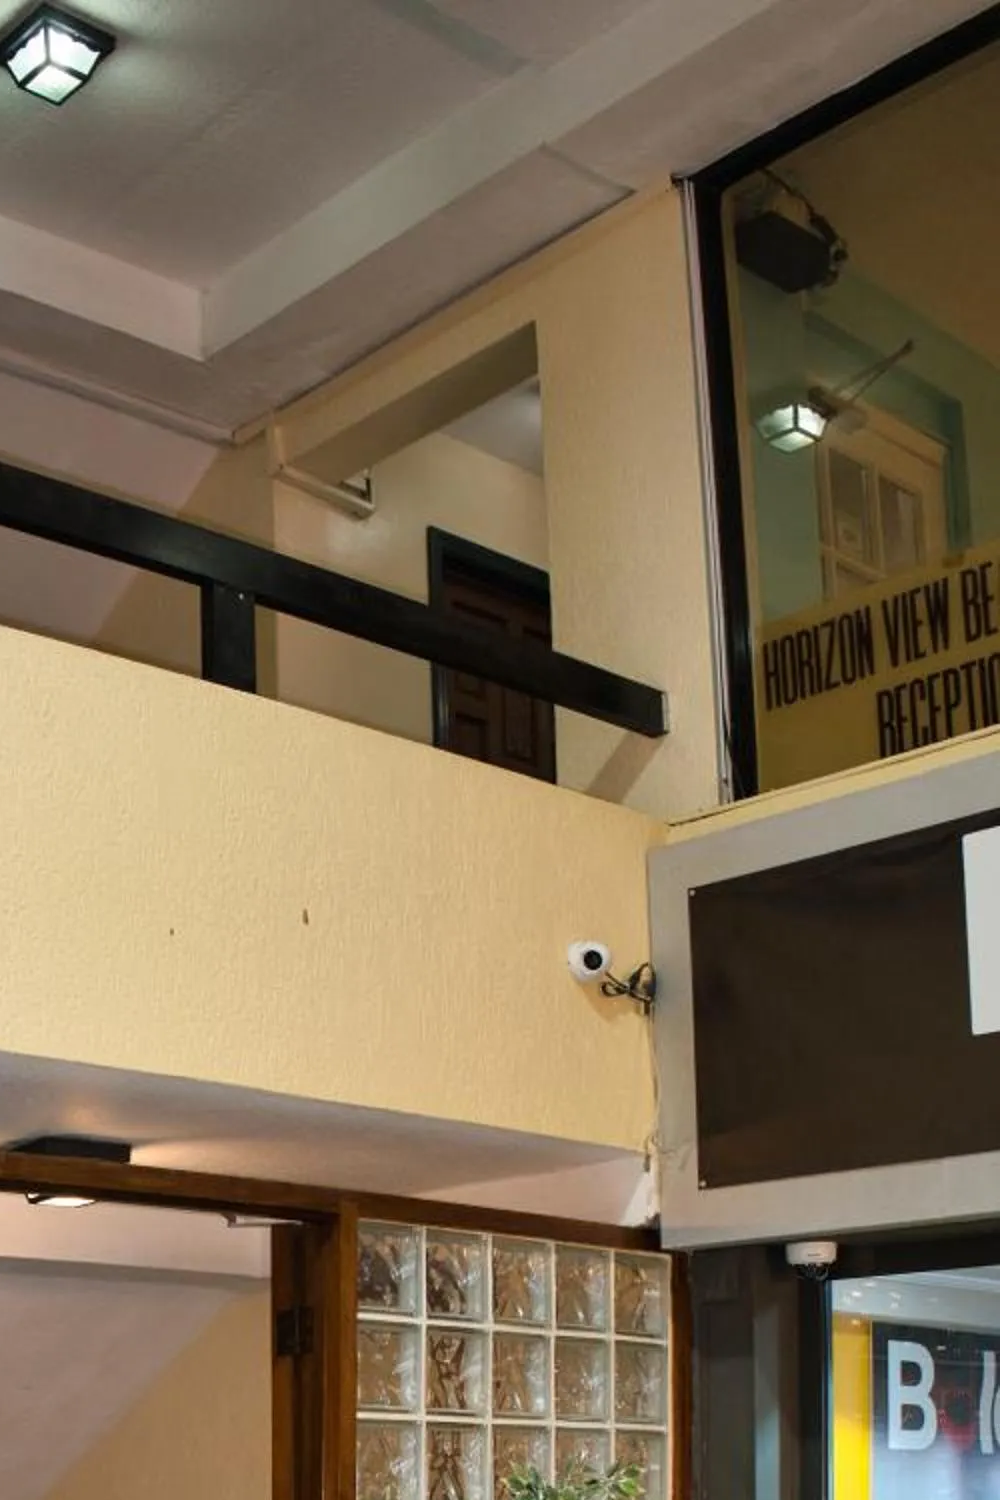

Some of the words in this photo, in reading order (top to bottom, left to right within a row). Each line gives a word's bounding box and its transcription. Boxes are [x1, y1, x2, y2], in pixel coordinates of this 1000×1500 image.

[762, 605, 876, 712] HORIZON
[881, 576, 951, 669] VIEW
[959, 560, 1000, 643] BE
